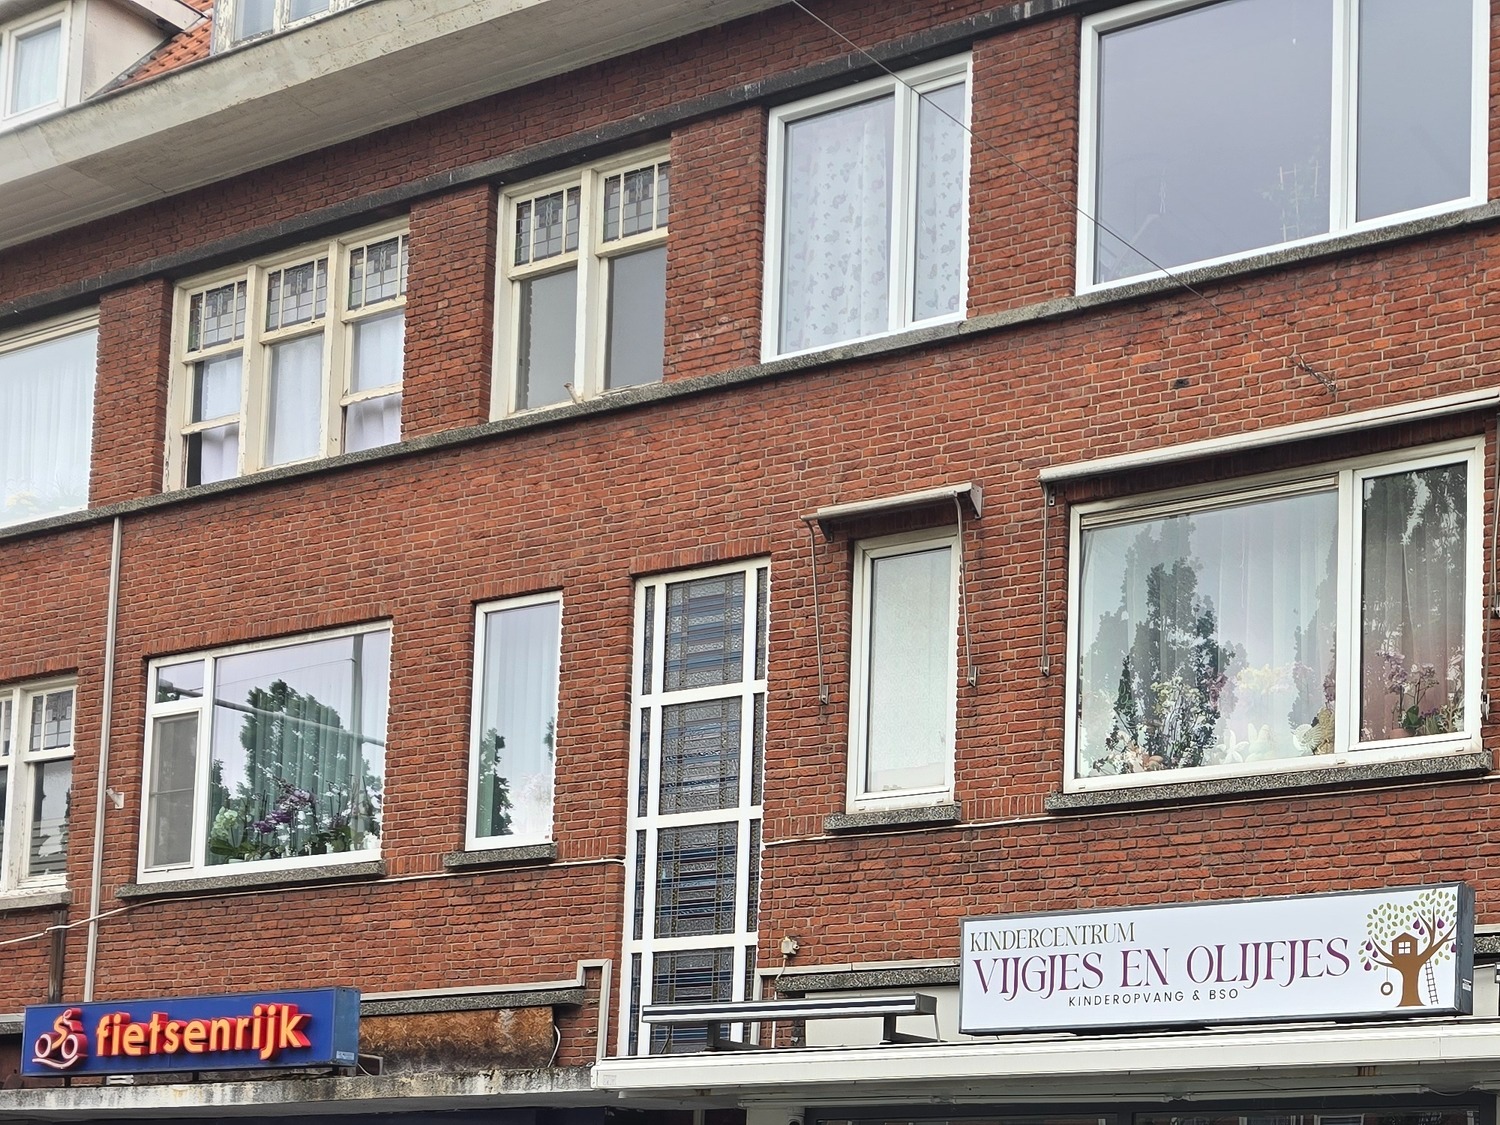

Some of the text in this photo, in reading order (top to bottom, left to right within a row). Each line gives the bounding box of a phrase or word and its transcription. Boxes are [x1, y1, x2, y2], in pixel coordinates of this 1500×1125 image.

[970, 922, 1135, 952] KINDERCENTRUM
[973, 937, 1350, 1001] VIJGJES EN OLIJFJES
[1069, 988, 1239, 1006] KINDEROPVANG & BSO
[97, 1003, 311, 1060] fietsenrijk
